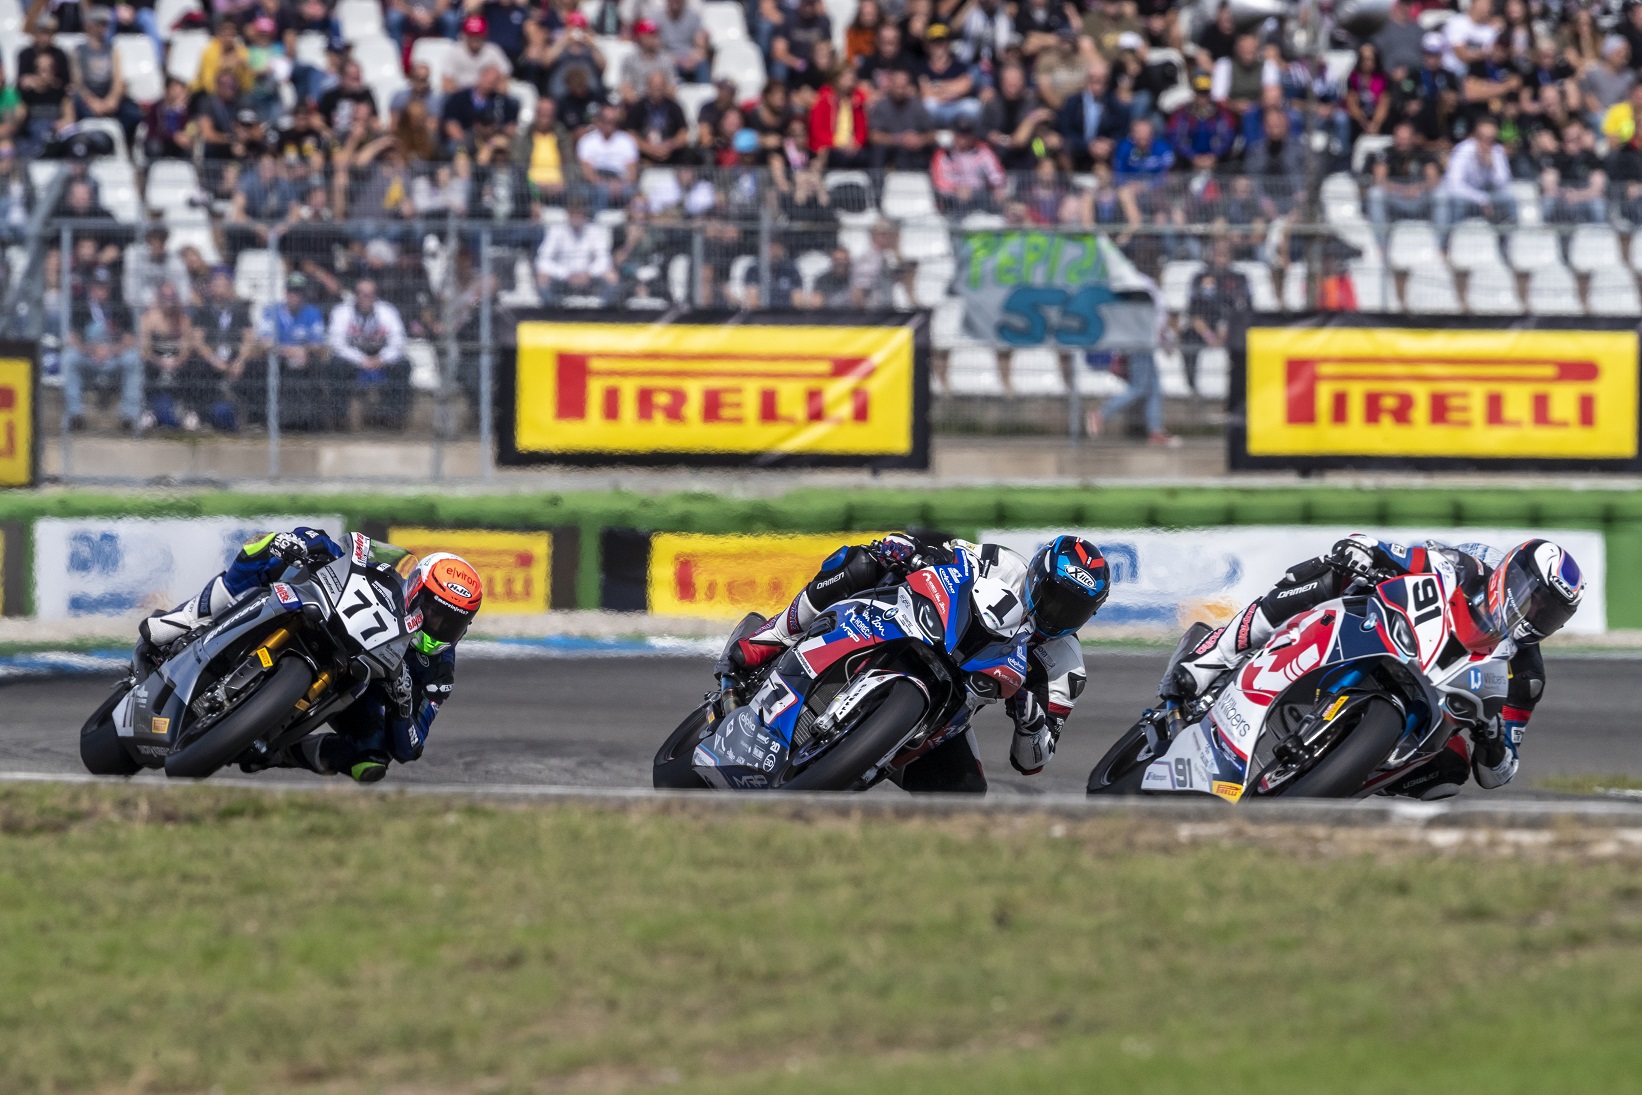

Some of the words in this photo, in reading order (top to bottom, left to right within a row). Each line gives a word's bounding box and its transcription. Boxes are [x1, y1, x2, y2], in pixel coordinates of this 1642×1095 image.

[555, 353, 876, 422] PIRELLI
[1286, 358, 1600, 426] PIRELLI
[274, 584, 290, 603] BAYER
[449, 584, 470, 597] HJC
[816, 572, 845, 589] DAMEN
[1277, 582, 1318, 599] DAMEN
[1554, 578, 1575, 599] HJC
[342, 588, 388, 642] 77
[986, 588, 1019, 627] 1
[1412, 577, 1442, 628] 91
[840, 622, 860, 643] MRP
[1218, 690, 1251, 738] Wilbers
[1174, 757, 1194, 789] 91
[1216, 784, 1241, 798] PIRELLI
